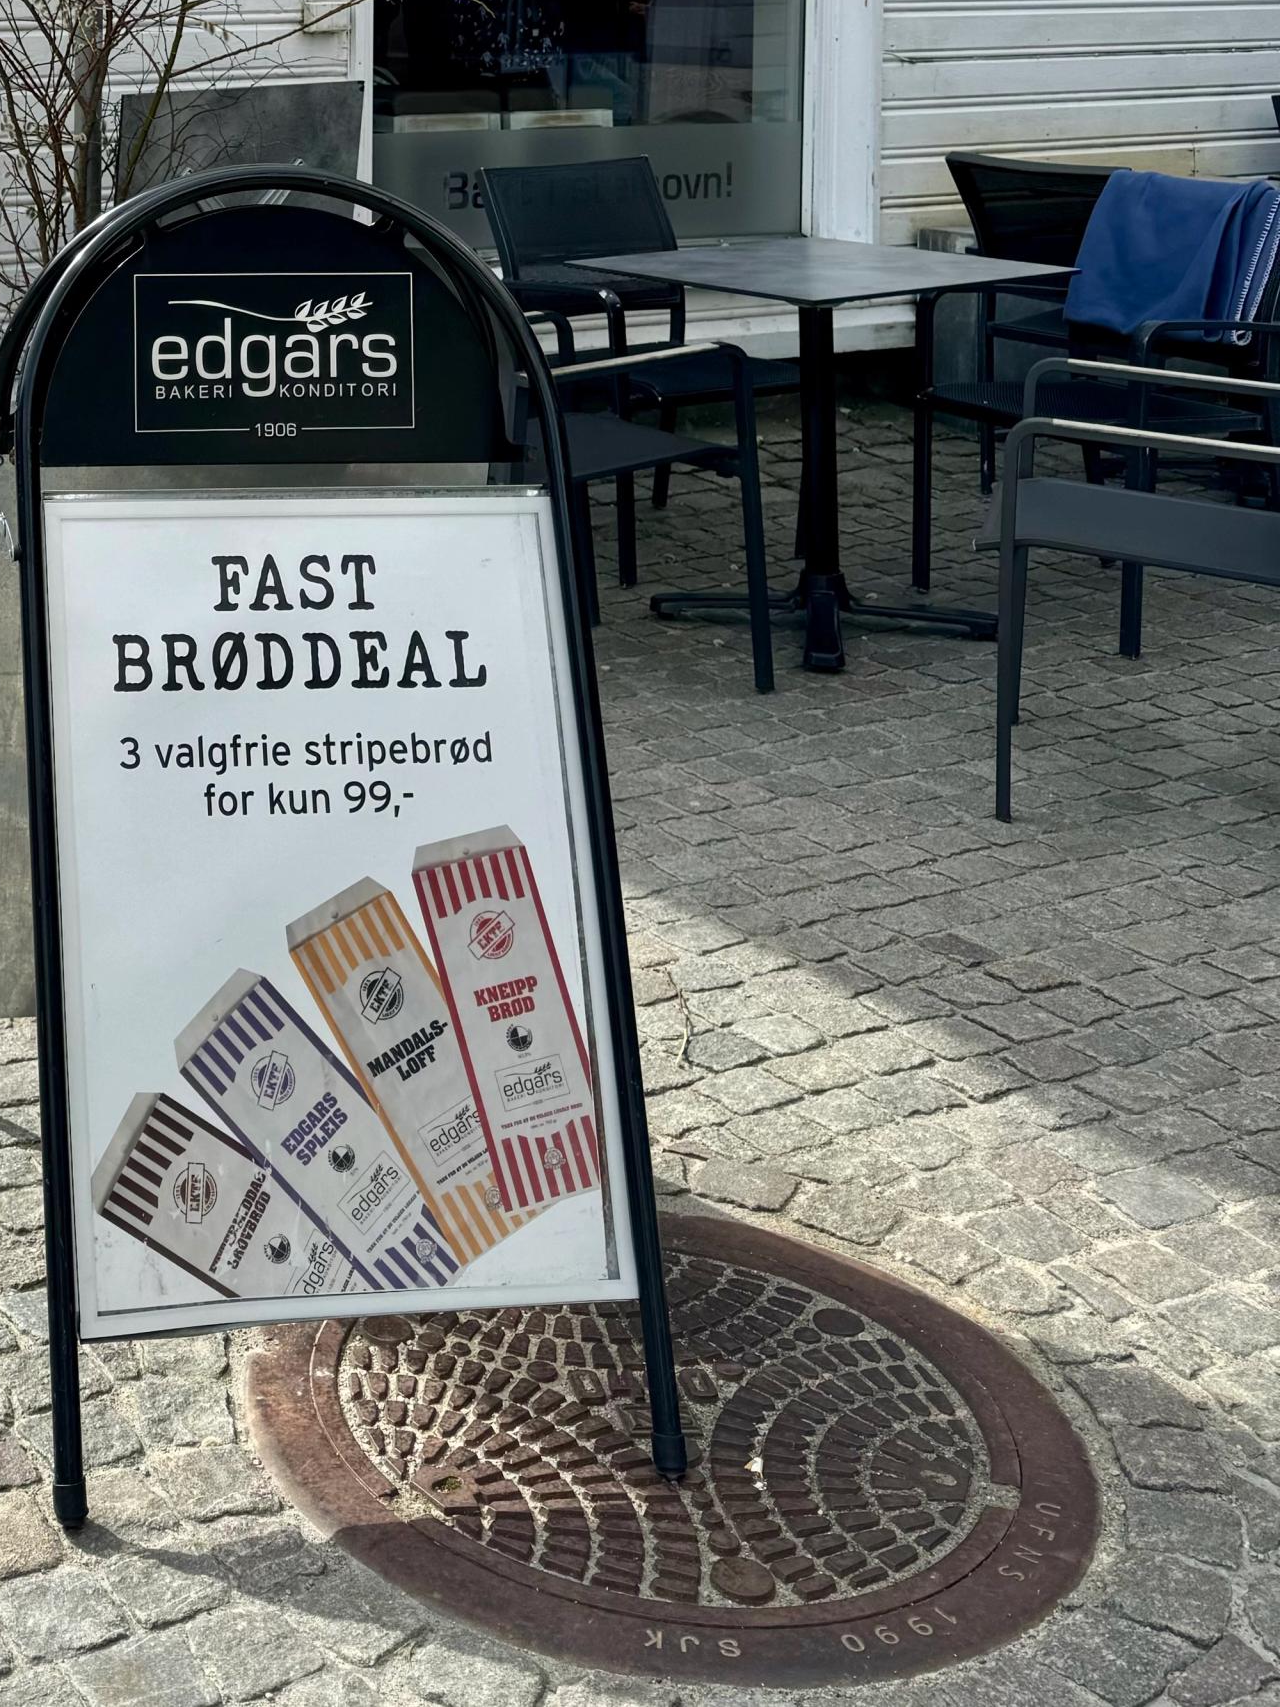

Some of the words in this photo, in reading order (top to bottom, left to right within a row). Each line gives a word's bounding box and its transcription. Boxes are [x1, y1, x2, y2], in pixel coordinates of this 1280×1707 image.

[151, 317, 398, 398] edgars
[155, 384, 233, 400] BAKERI
[279, 382, 397, 398] KONDITORI
[254, 422, 297, 437] 1906
[211, 553, 377, 612] FAST
[112, 630, 487, 693] BRØDDEAL
[119, 736, 141, 770] 3
[154, 734, 291, 775] valgfrie
[304, 730, 493, 772] stripebrød
[203, 783, 255, 817] for
[267, 782, 331, 816] kun
[343, 780, 414, 818] 99,-
[369, 978, 395, 1013] EKTE
[473, 975, 538, 1007] KNEIPP
[487, 995, 536, 1023] BRØD
[366, 1019, 448, 1078] MANDALS-
[395, 1044, 436, 1081] LOFF
[503, 1070, 563, 1097] edgars
[280, 1091, 338, 1156] EDGARS
[296, 1107, 348, 1166] SPLEIS
[429, 1109, 481, 1152] edgars
[351, 1166, 399, 1221] edgars
[302, 1241, 334, 1294] dgars
[644, 1628, 743, 1659] SJK
[840, 1606, 958, 1654] 1990
